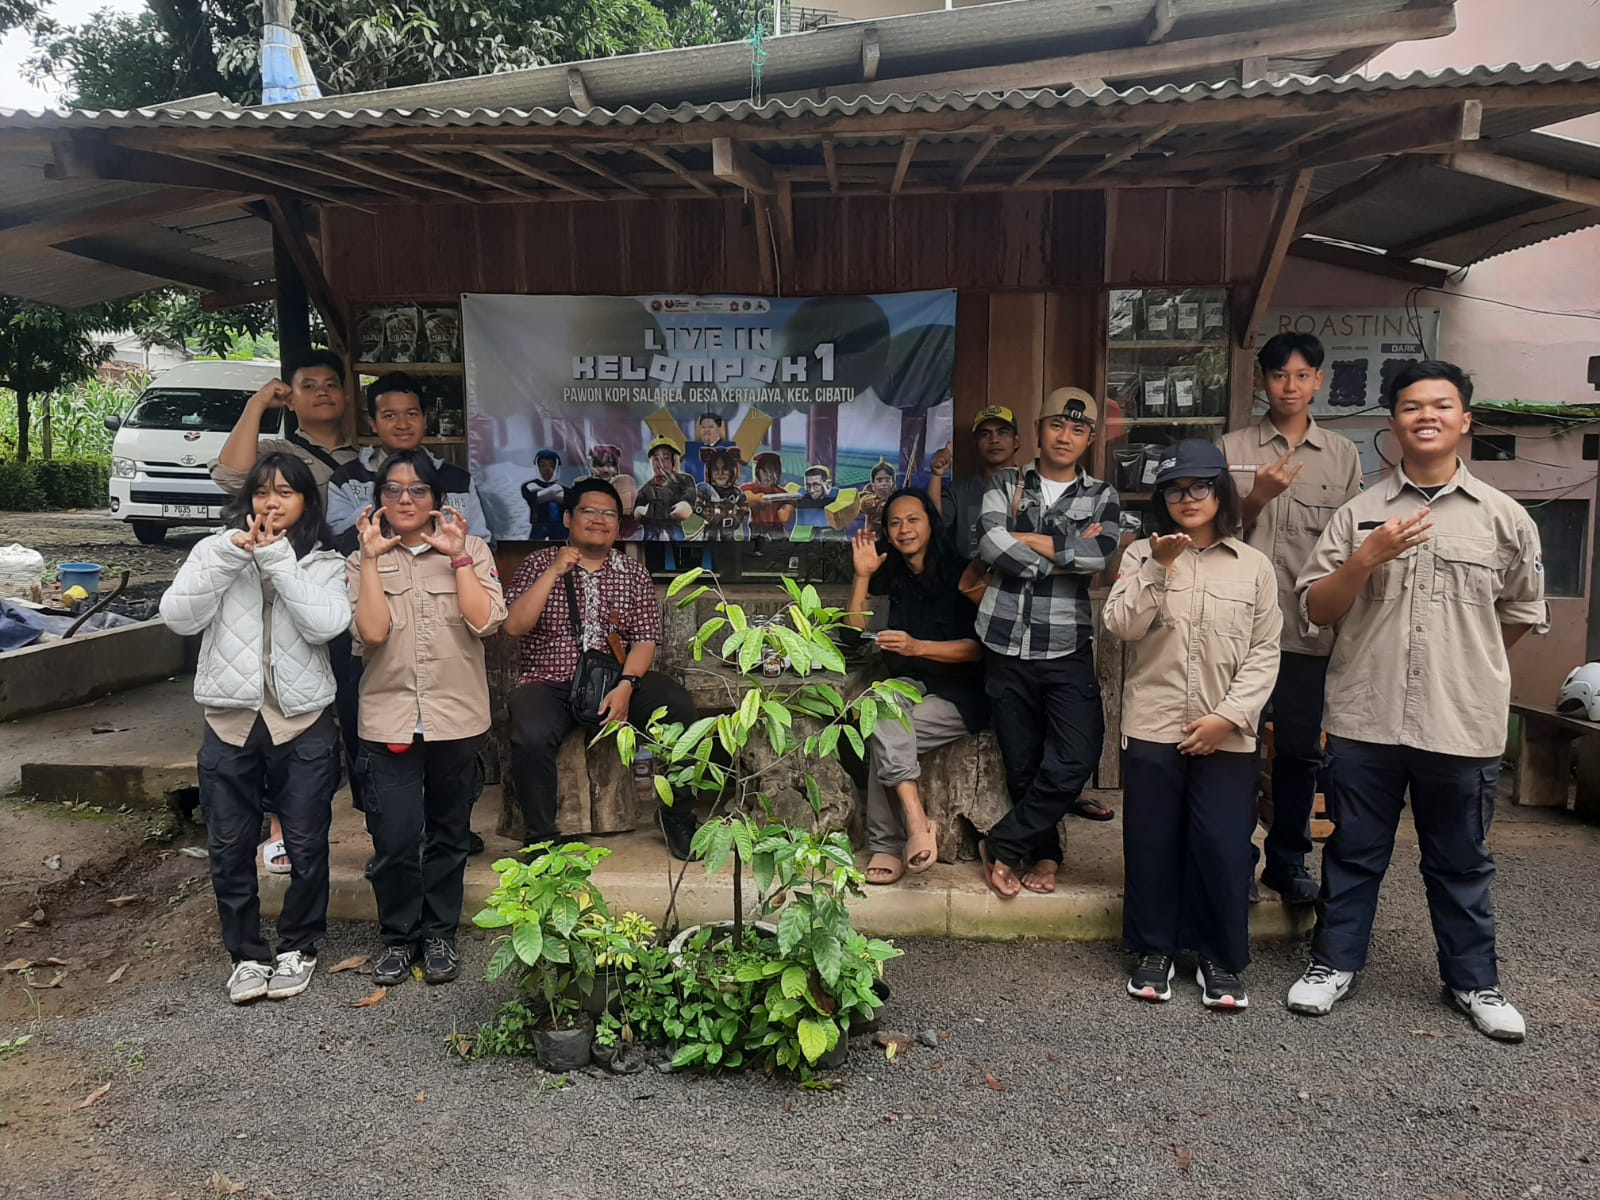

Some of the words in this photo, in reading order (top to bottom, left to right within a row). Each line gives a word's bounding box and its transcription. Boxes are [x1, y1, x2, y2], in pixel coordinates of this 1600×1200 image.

[644, 328, 723, 350] LIVE
[735, 328, 772, 350] IN
[1391, 344, 1416, 353] DARK
[571, 353, 808, 384] KELOMPOK
[813, 342, 835, 382] 1
[563, 387, 603, 402] PAWON
[605, 387, 630, 402] KOPI
[632, 387, 687, 403] SALAREA,
[689, 387, 718, 402] DESA
[721, 387, 785, 403] KERTAJAYA,
[787, 387, 812, 402] KEC.
[815, 387, 855, 402] CIBATU
[164, 505, 169, 513] D
